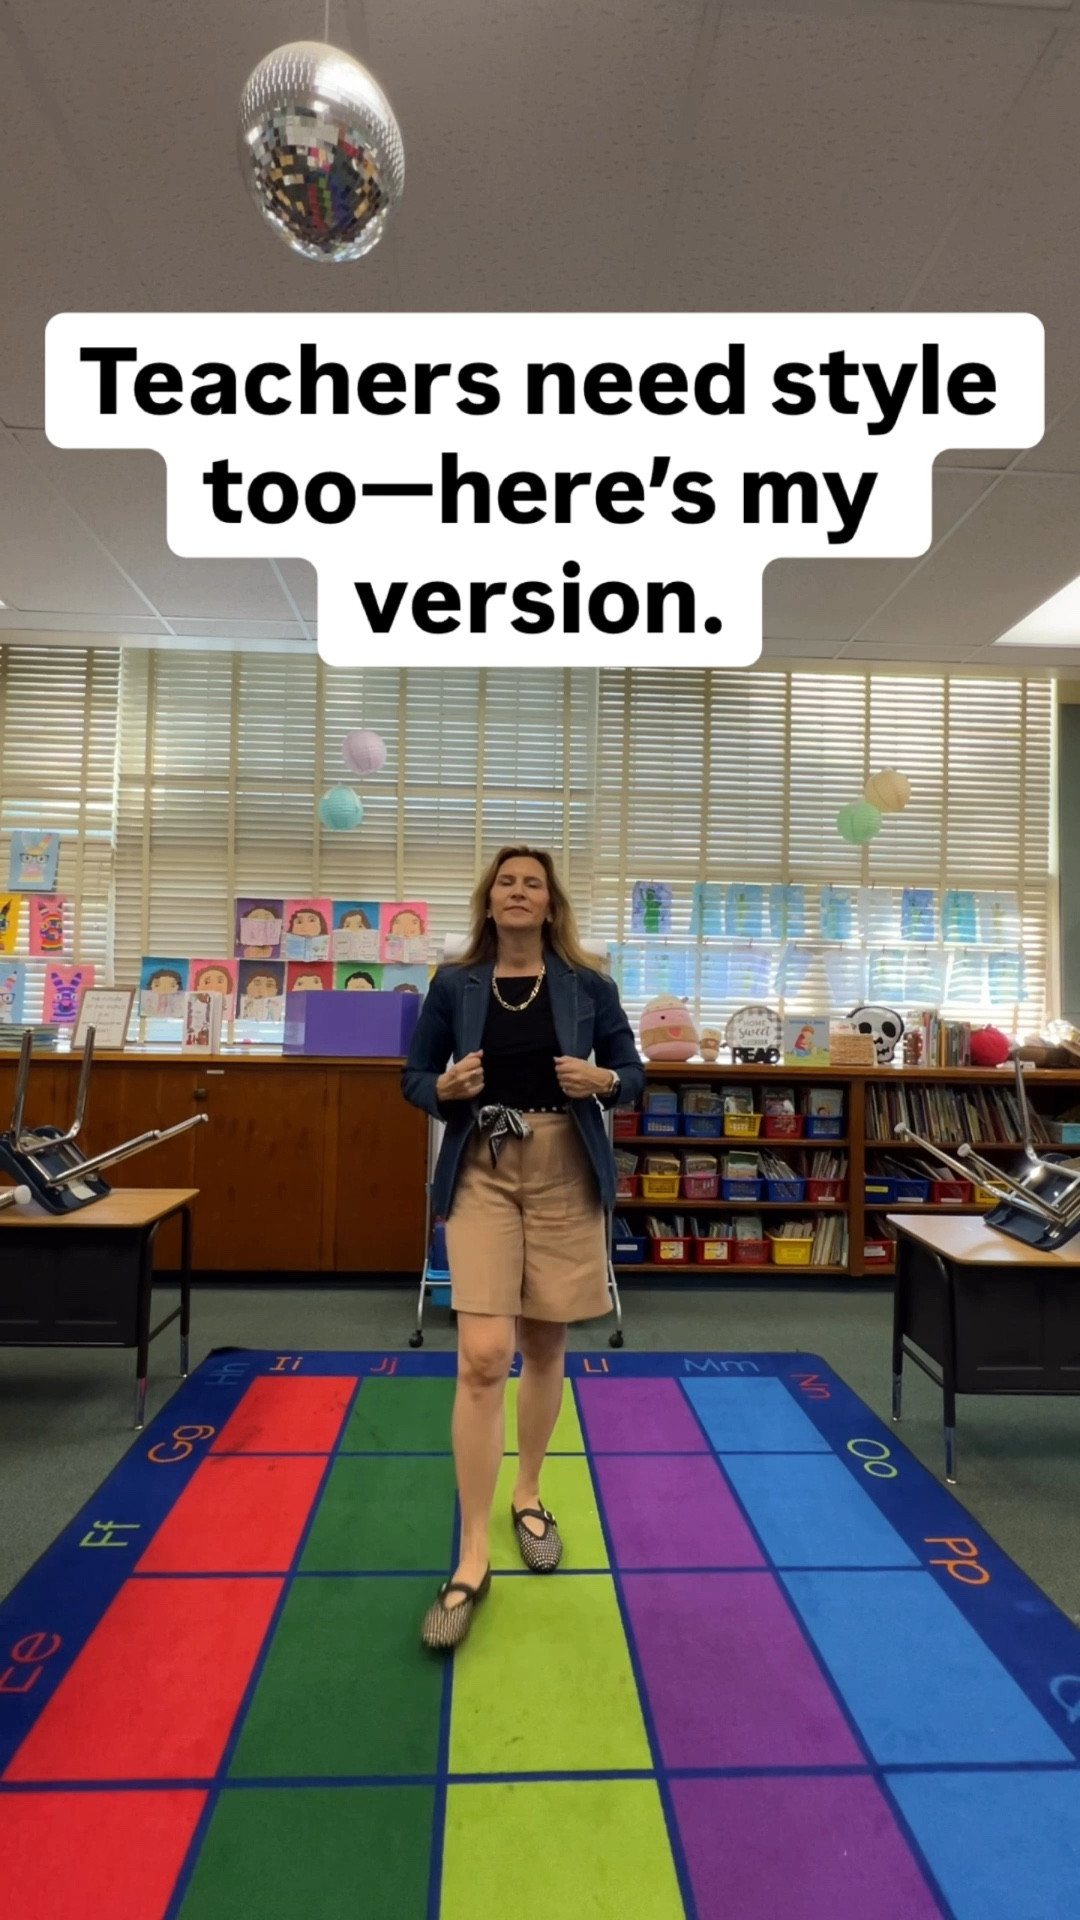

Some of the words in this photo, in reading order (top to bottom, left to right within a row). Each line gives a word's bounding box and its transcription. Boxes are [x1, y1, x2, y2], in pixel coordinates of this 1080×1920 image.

[732, 1047, 780, 1064] READ
[269, 1355, 304, 1371] Ii
[369, 1357, 400, 1376] Jj
[683, 1357, 760, 1373] Mm
[790, 1373, 832, 1399] Nn
[147, 1424, 216, 1463] Gg
[846, 1437, 899, 1479] Oo
[79, 1520, 142, 1547] Ff
[923, 1537, 991, 1585] Pp
